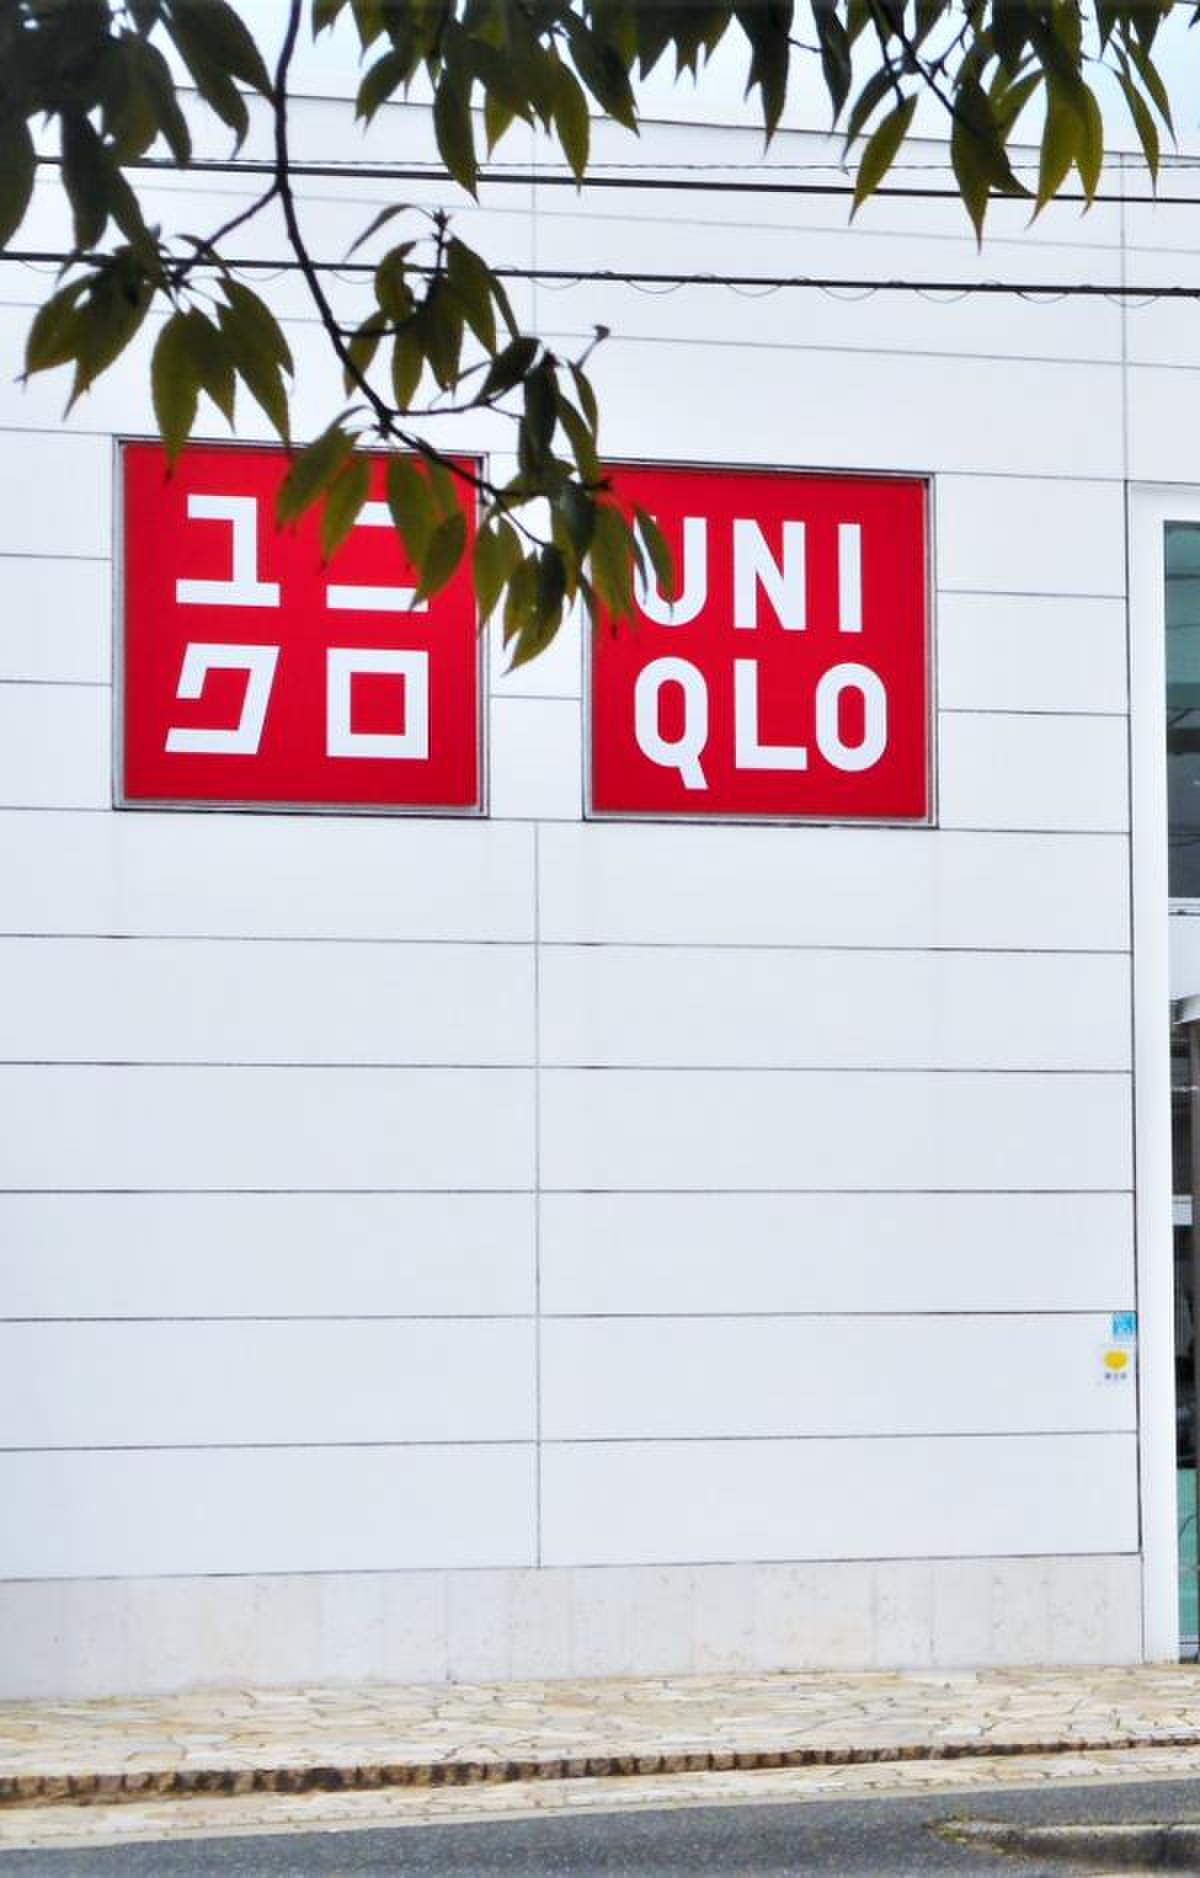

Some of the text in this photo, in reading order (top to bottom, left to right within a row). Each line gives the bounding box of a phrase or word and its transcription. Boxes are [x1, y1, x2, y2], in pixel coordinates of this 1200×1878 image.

[175, 493, 429, 612] ユニ
[633, 516, 863, 633] UNI
[164, 642, 429, 760] クロ
[633, 656, 888, 790] QLO
